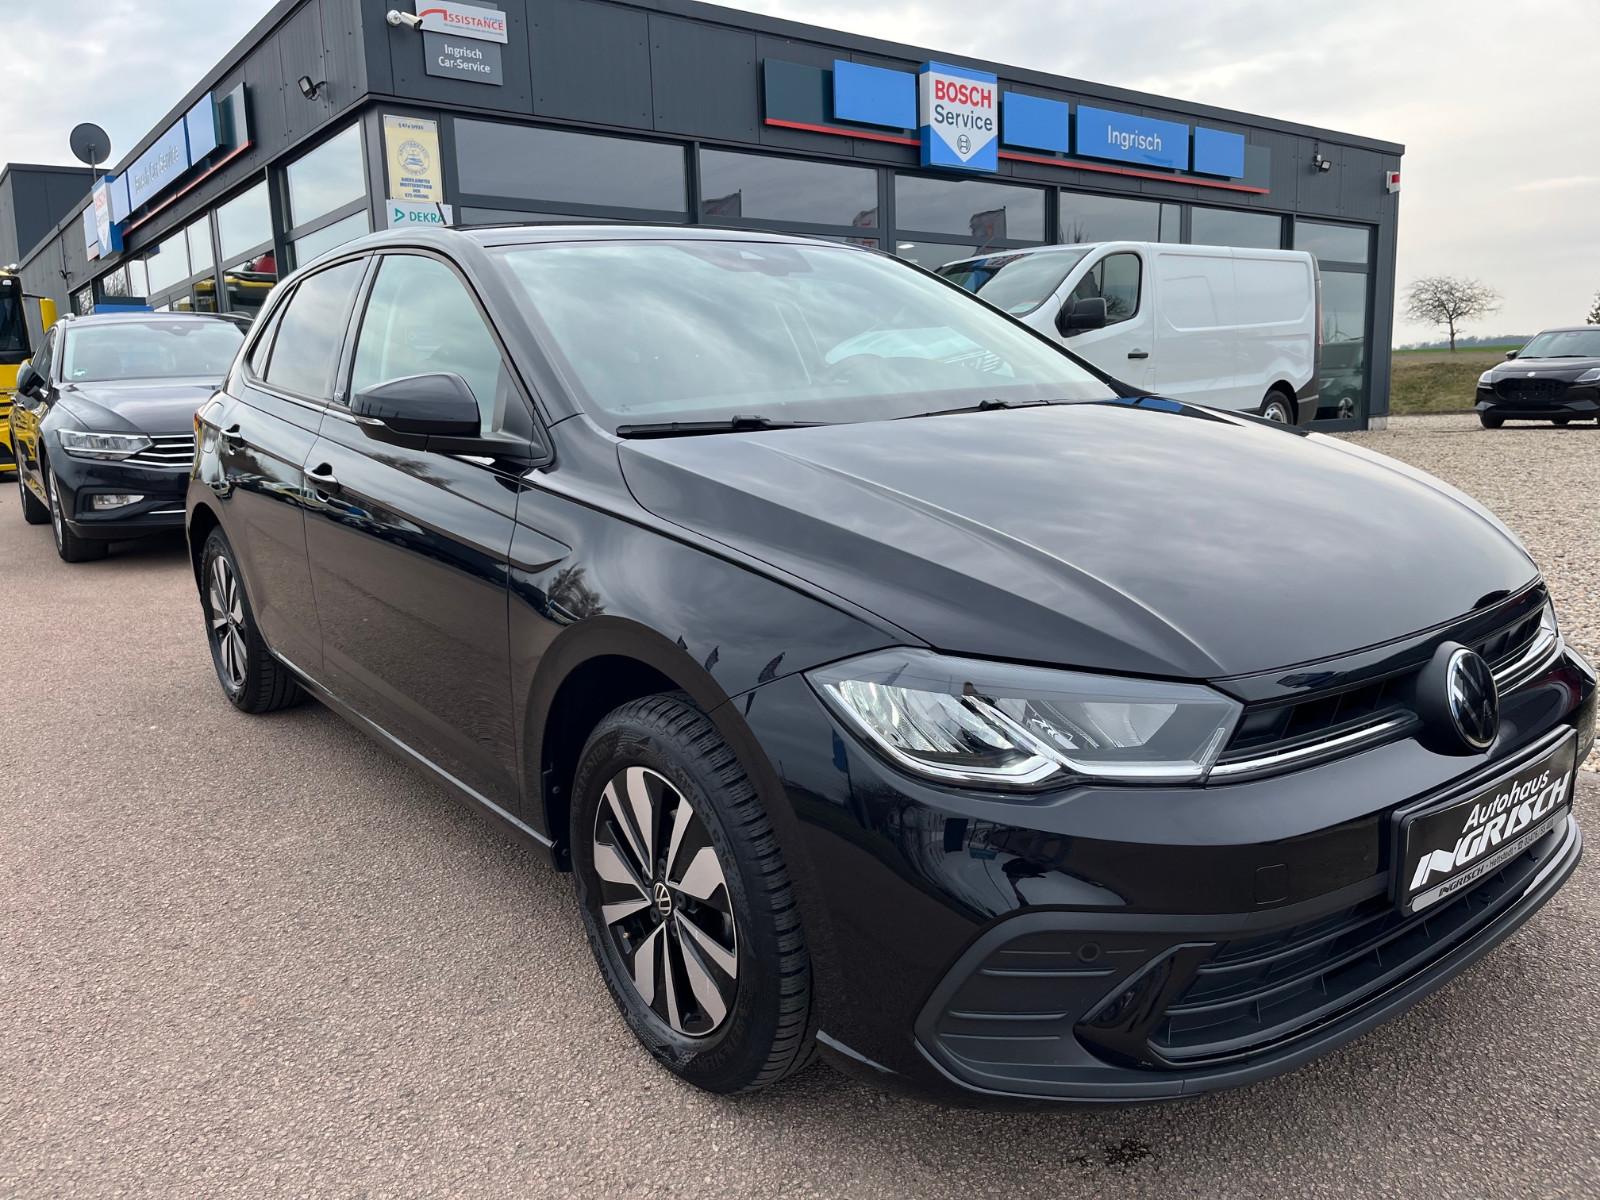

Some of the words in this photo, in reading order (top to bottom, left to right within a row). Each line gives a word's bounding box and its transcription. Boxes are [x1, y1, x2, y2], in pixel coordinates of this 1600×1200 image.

[438, 57, 491, 73] Car-Service
[444, 44, 482, 60] Ingrisch
[934, 80, 992, 109] BOSCH
[934, 104, 993, 132] Service
[1107, 125, 1162, 151] Ingrisch
[1462, 770, 1550, 834] Autohaus
[1409, 770, 1571, 891] INGRISCH
[1438, 866, 1485, 897] INGRISCH
